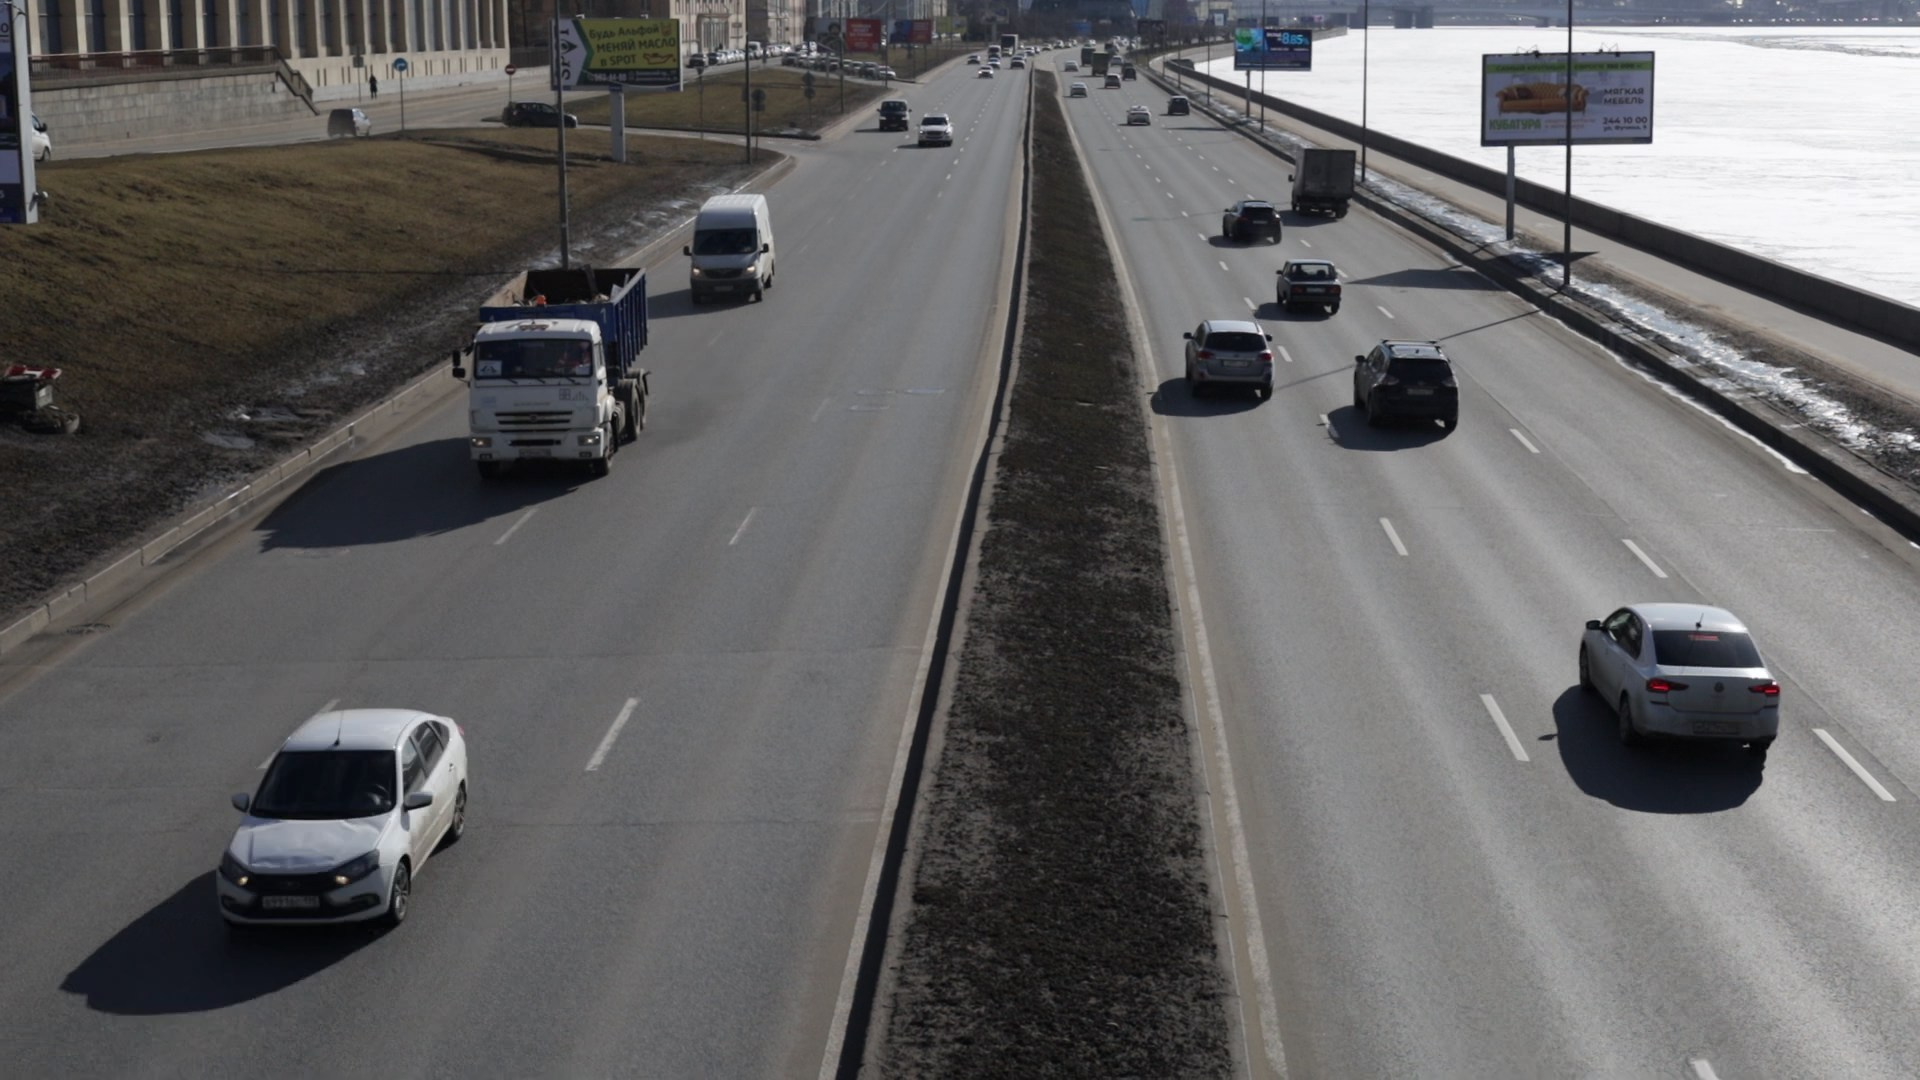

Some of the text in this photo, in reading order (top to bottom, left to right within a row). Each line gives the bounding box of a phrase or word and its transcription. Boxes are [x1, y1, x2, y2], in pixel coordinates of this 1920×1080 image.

[589, 25, 659, 41] Будь Альфой
[597, 37, 676, 53] МЕНЯЙ МАСЛО
[610, 55, 636, 66] SPOT
[1604, 97, 1644, 105] МЕБЕЛЬ
[1489, 118, 1542, 130] КУБАТУРА
[1602, 116, 1621, 125] 244
[1623, 116, 1633, 124] 10
[1635, 116, 1648, 124] 00
